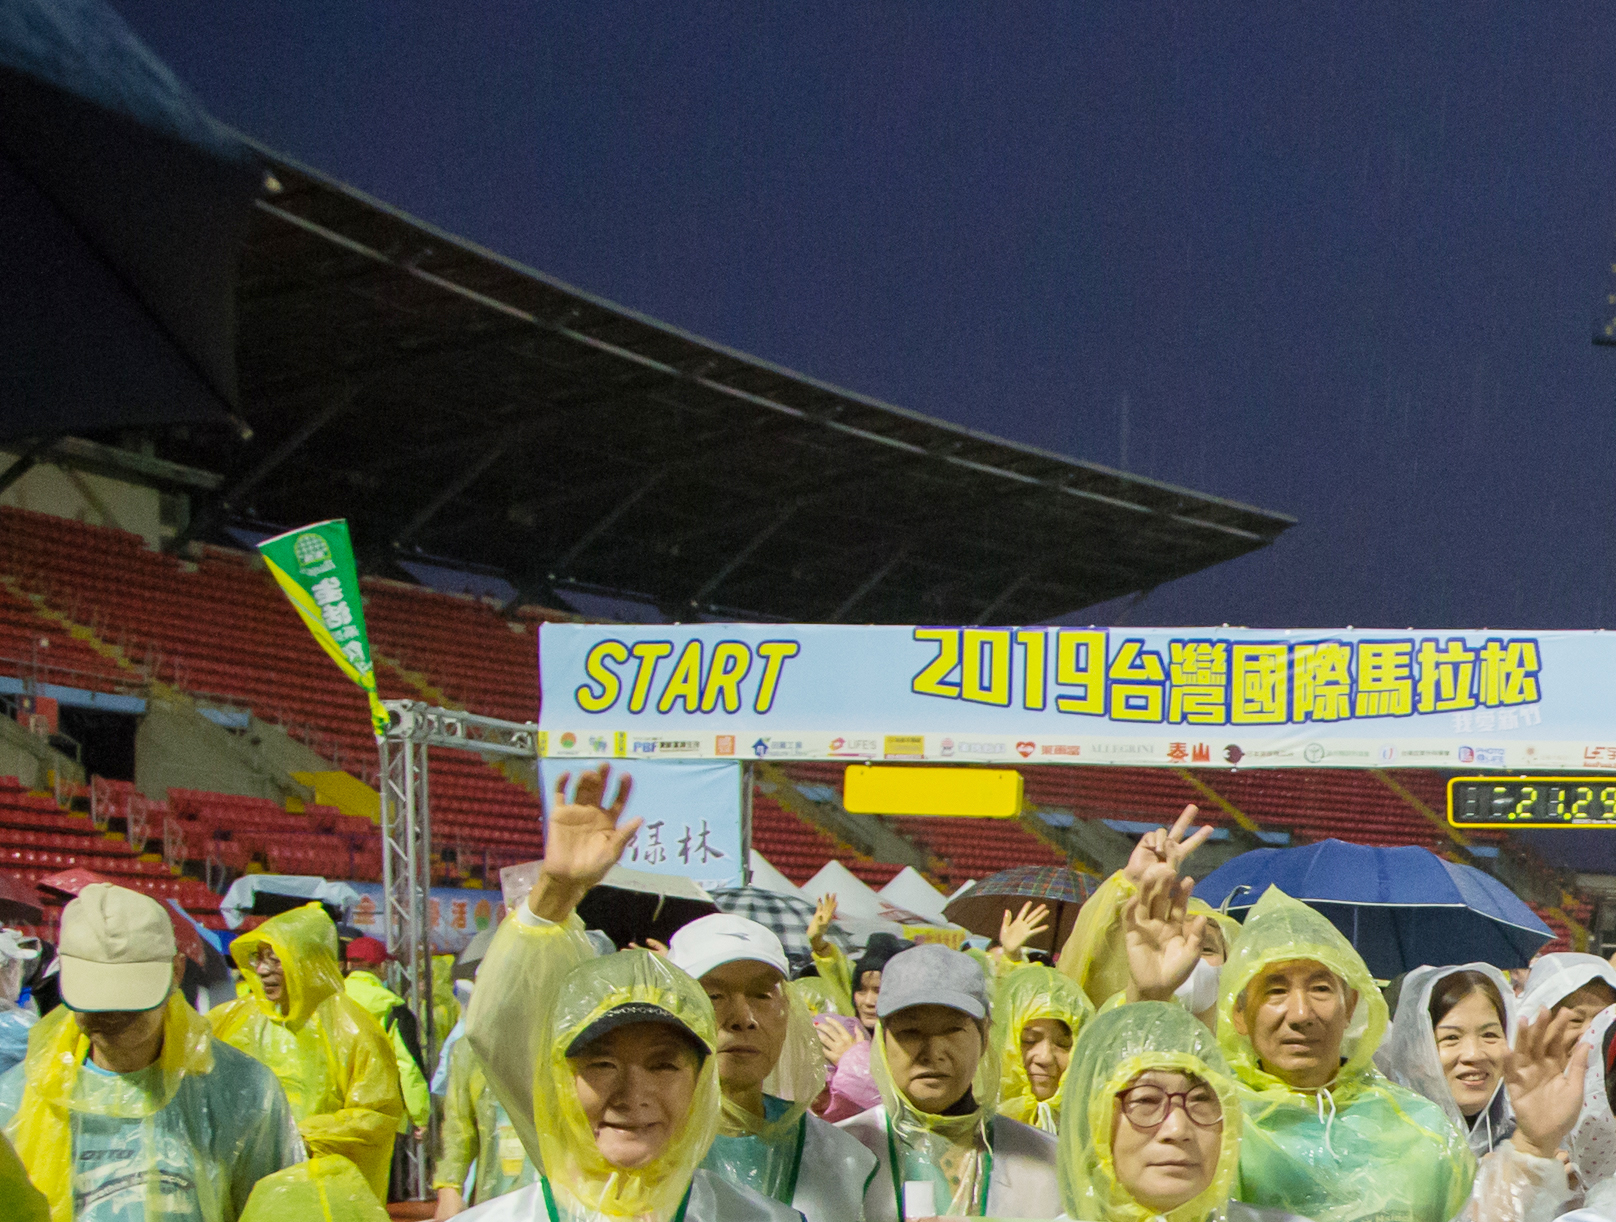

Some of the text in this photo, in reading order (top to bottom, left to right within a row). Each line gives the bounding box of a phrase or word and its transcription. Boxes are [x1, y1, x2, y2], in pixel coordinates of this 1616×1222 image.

[574, 638, 800, 715] START
[910, 627, 1543, 726] 2019台灣國際馬拉松
[1166, 742, 1212, 763] 泰山
